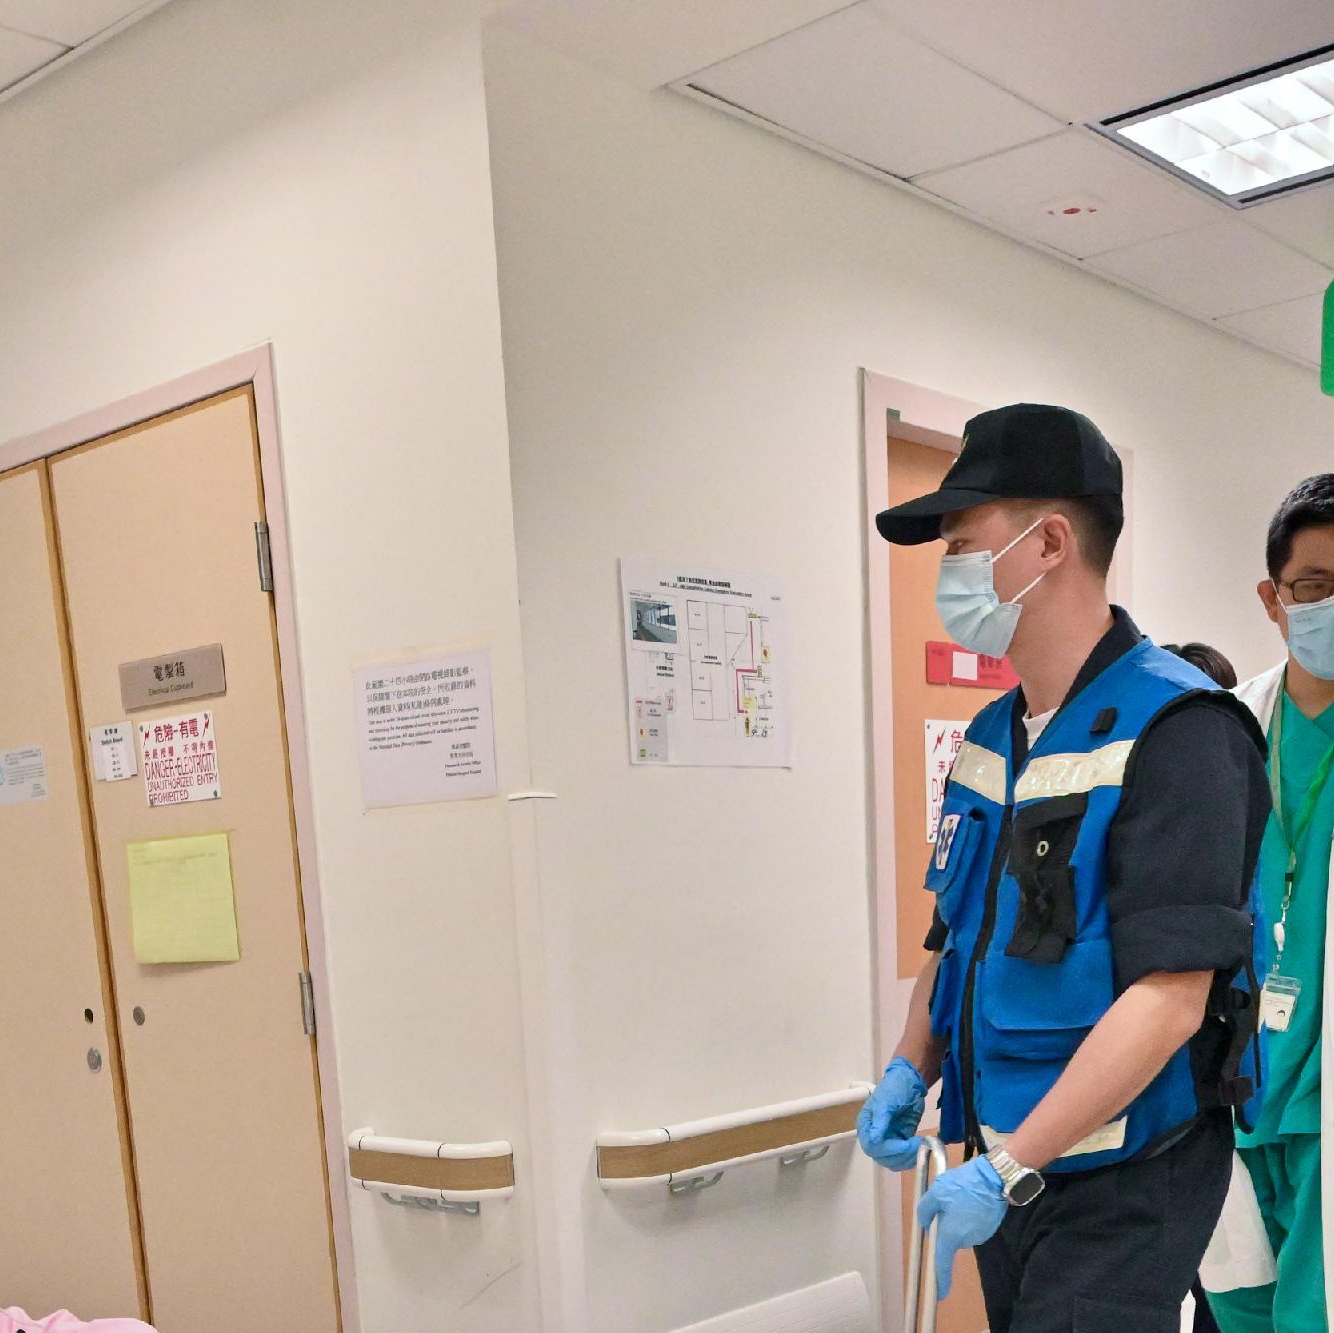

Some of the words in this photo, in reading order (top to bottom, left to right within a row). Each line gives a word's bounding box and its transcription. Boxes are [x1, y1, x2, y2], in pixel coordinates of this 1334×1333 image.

[147, 776, 194, 793] UNAUTHORIZED
[197, 772, 218, 786] ENTRY
[148, 790, 189, 804] PROHIBITED
